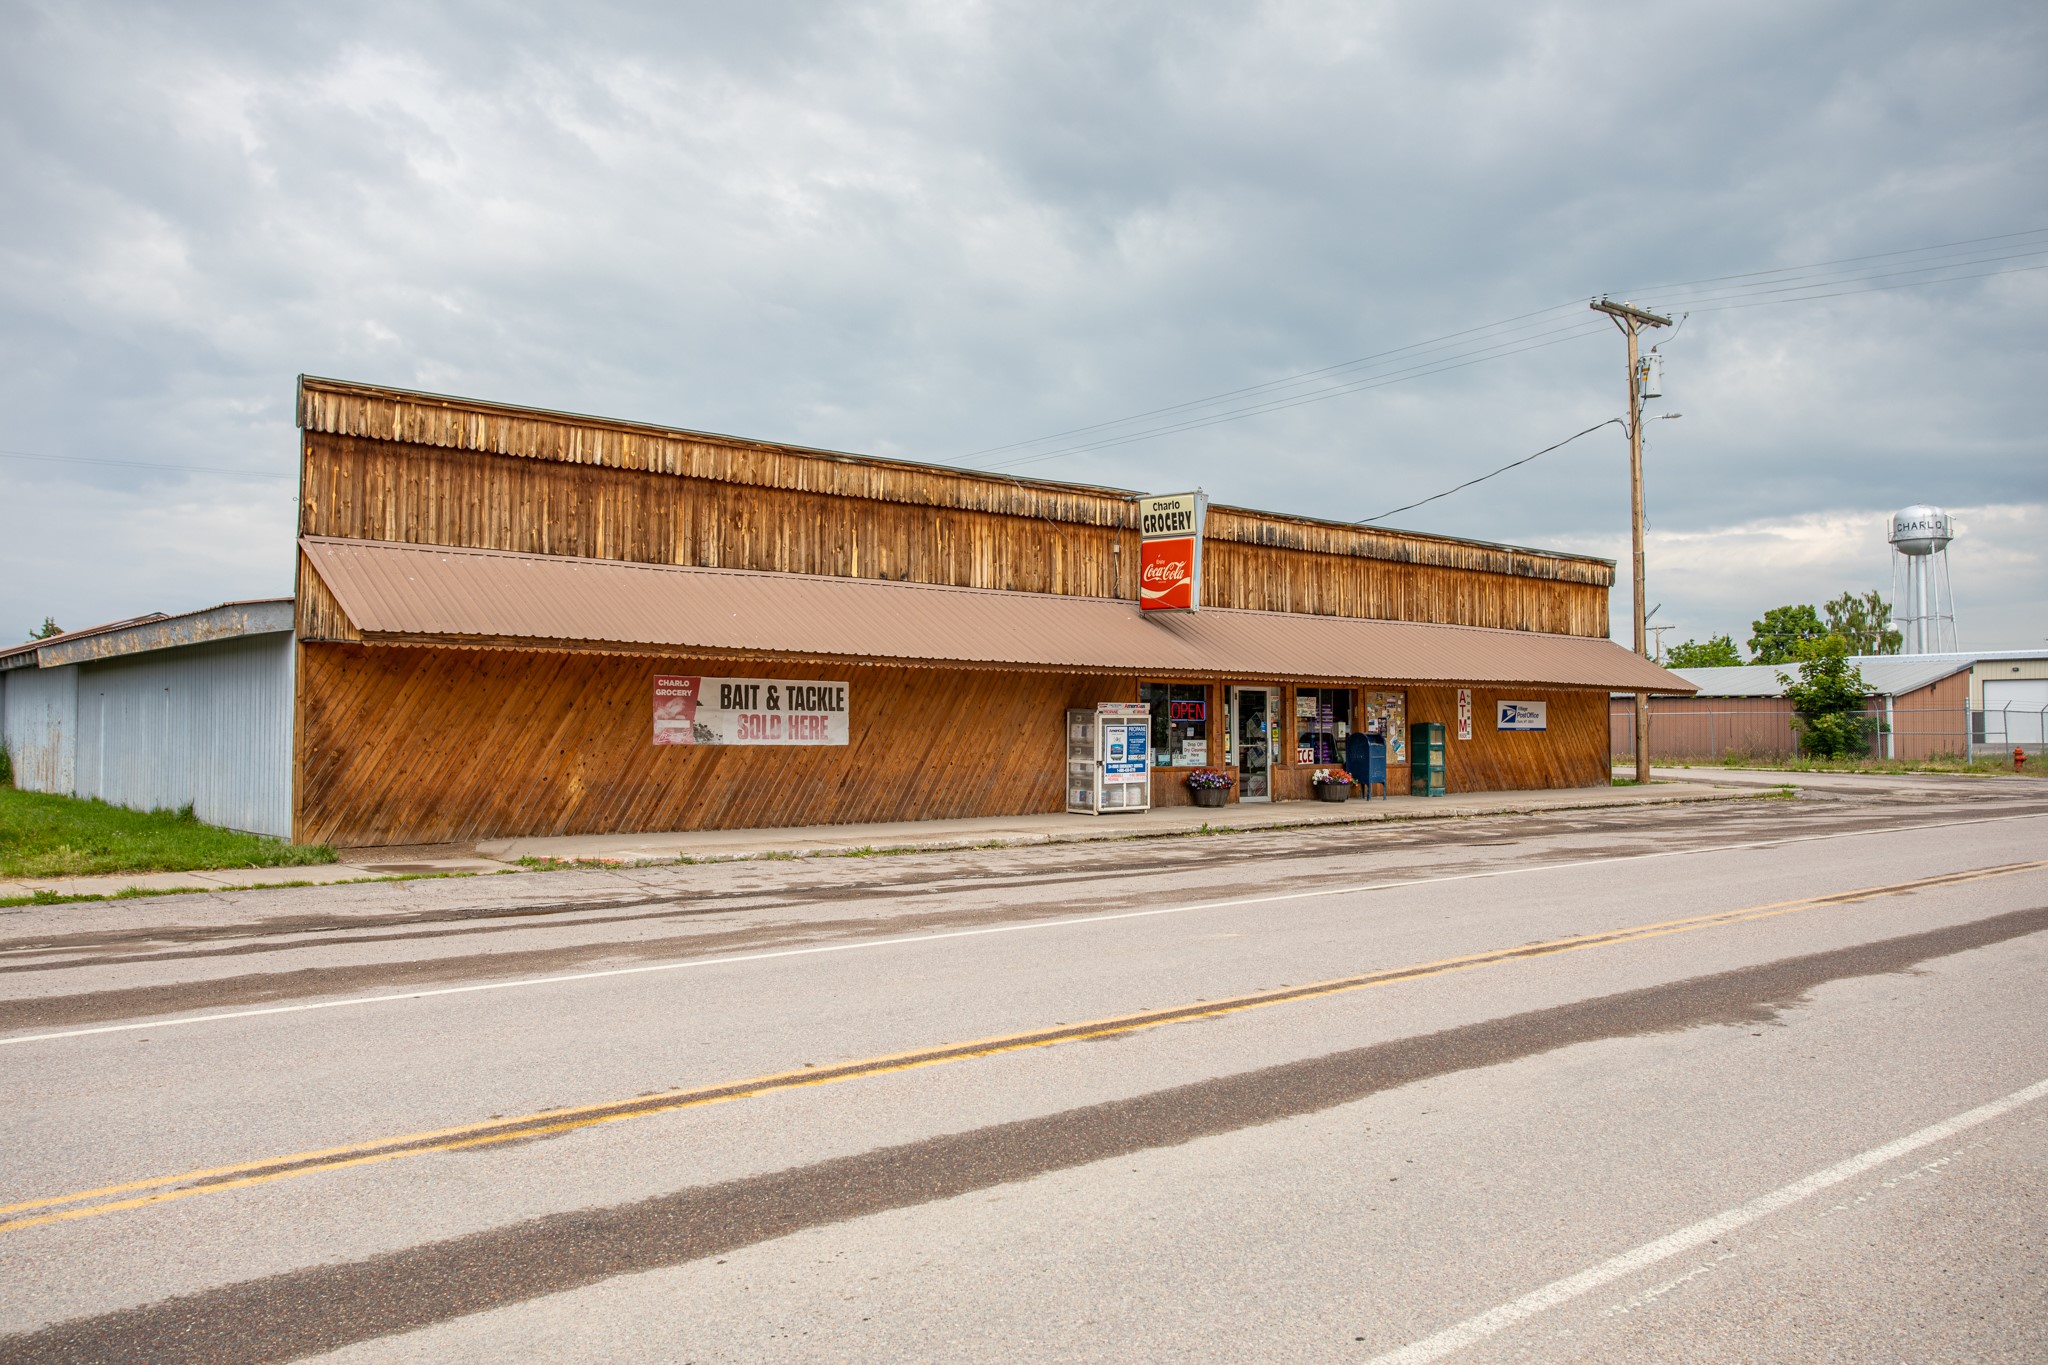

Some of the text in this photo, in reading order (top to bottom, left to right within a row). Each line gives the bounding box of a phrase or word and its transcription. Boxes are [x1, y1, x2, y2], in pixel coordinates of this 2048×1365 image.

[1152, 500, 1180, 511] Charlo
[1143, 510, 1191, 533] GROCERY
[1897, 521, 1942, 532] CHARLO
[658, 679, 690, 687] CHARLO
[720, 684, 844, 712] BAIT & TACKLE
[1171, 702, 1205, 720] OPEN
[1459, 690, 1467, 732] ATM
[737, 714, 829, 740] SOLD HERE
[1297, 749, 1313, 763] ICE
